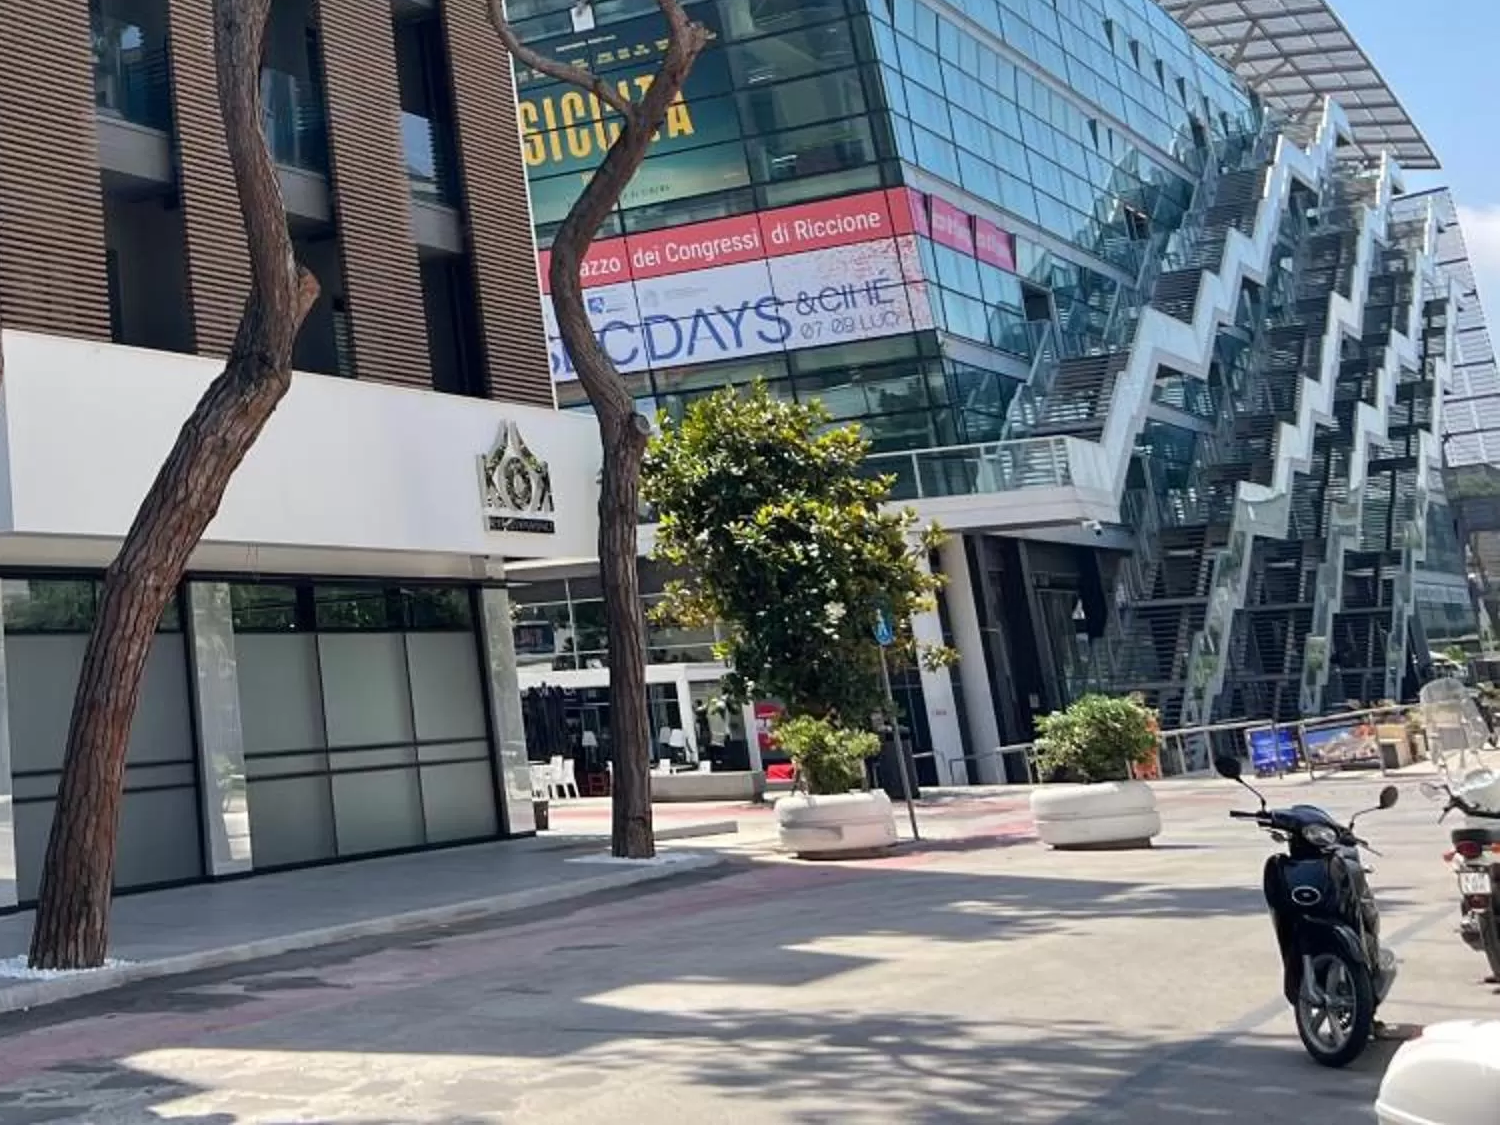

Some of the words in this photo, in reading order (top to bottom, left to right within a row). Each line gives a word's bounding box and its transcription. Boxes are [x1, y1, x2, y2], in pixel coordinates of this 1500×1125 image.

[580, 256, 621, 277] azzo
[633, 247, 661, 269] dei
[665, 228, 760, 263] Congressi
[771, 222, 790, 245] di
[794, 211, 882, 242] Riccione
